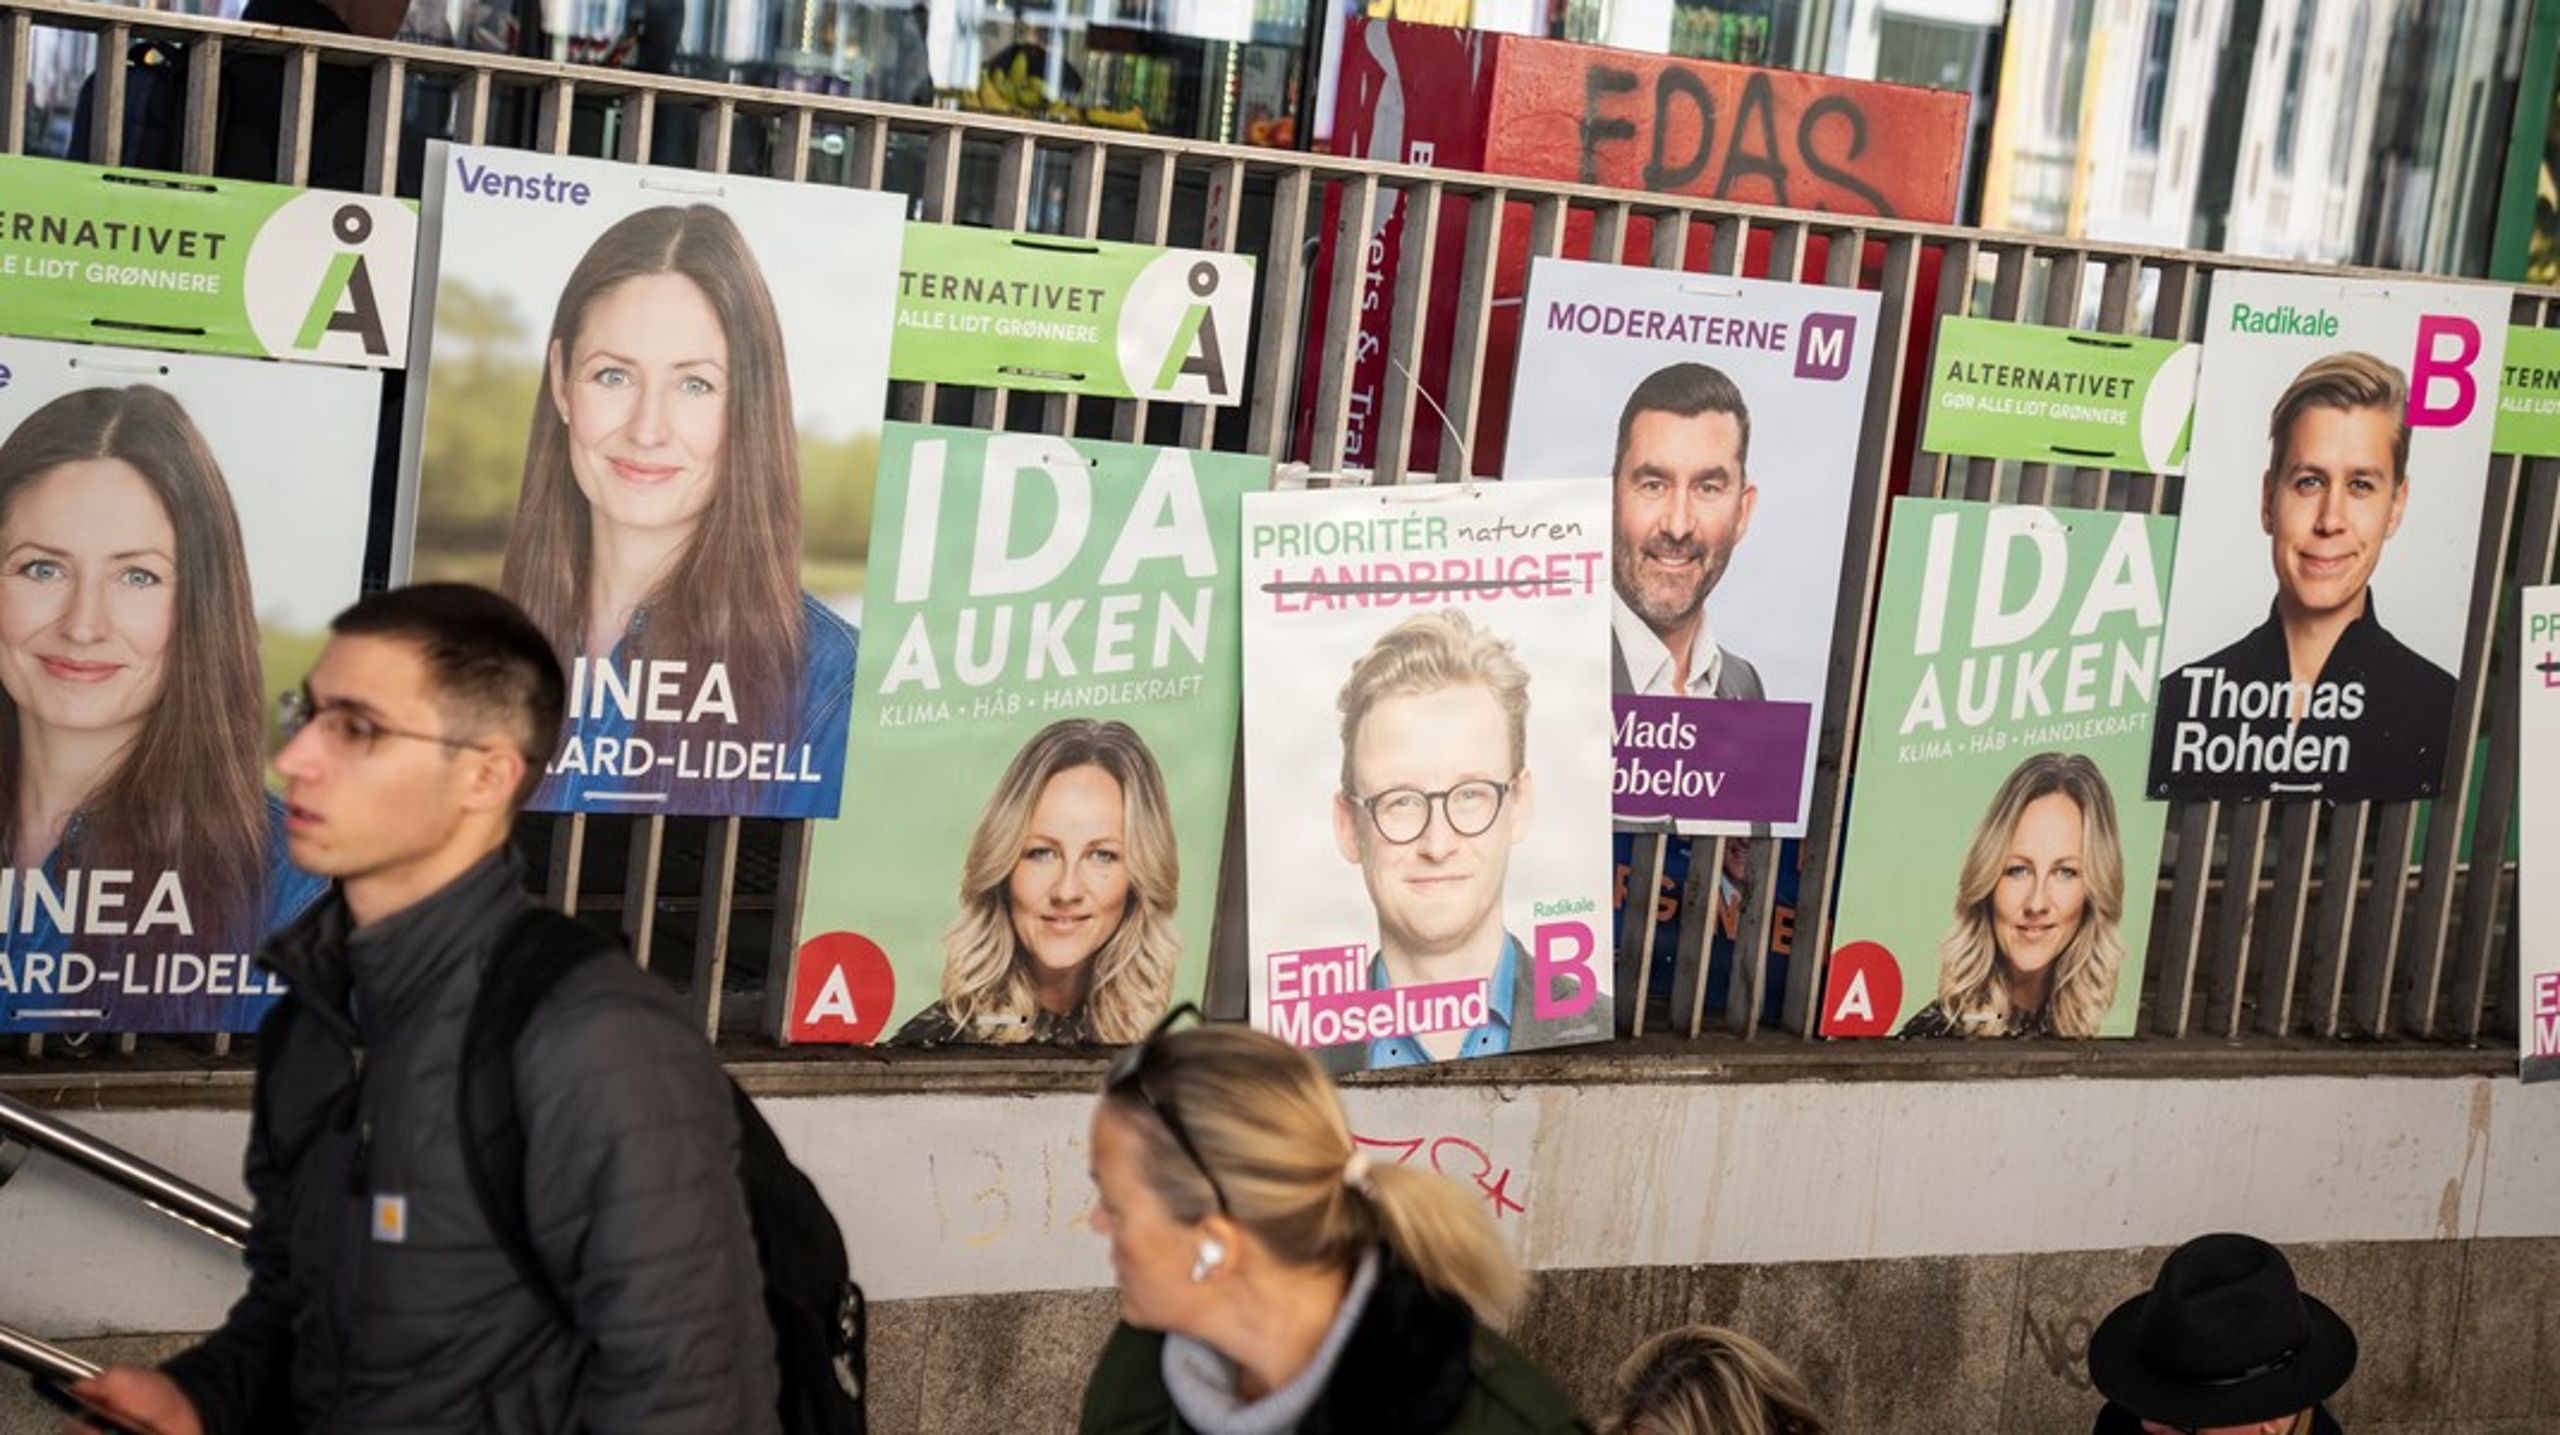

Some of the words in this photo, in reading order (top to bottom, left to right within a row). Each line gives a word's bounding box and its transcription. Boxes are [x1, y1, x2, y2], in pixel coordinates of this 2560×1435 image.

[456, 156, 591, 206] Venstre
[24, 256, 81, 281] LIDT
[85, 261, 221, 294] GRØNNERE
[293, 203, 390, 357] Å
[899, 271, 1106, 314] TERNATIVET
[897, 308, 944, 330] ALLE
[948, 313, 992, 334] LIDT
[995, 316, 1099, 343] GRØNNERE
[1153, 260, 1228, 396] Å
[1547, 301, 1788, 351] MODERATERNE
[2230, 303, 2339, 338] Radikale
[1805, 327, 1846, 368] M
[2404, 313, 2482, 429] B
[1947, 360, 2135, 399] ALTERNATIVET
[1942, 392, 1974, 410] GØR
[1978, 395, 2012, 414] ALLE
[2015, 399, 2048, 417] LIDT
[2050, 401, 2127, 426] GRØNNERE
[893, 434, 1219, 604] IDA
[1253, 511, 1448, 558] PRIORITÉR
[1458, 516, 1583, 543] naturen
[1274, 551, 1604, 613] LANDBRUGET
[1914, 505, 2164, 656] IDA
[878, 587, 1213, 695] AUKEN
[879, 702, 950, 728] KLIMA
[973, 688, 1020, 720] HÅB
[1042, 675, 1204, 711] HANDLEKRAFT
[1898, 635, 2159, 736] AUKEN
[2181, 667, 2366, 720] Thomas
[1612, 709, 1698, 750] Mads
[1898, 740, 1953, 764] KLIMA
[1969, 728, 2007, 754] HÅB
[2023, 712, 2150, 747] HANDLEKRAFT
[2171, 721, 2350, 774] Rohden
[545, 736, 822, 782] ARD-LIDELL
[1533, 898, 1595, 918] Radikale
[803, 962, 858, 1025] A
[1270, 946, 1367, 1001] Emil
[1533, 920, 1598, 1022] B
[1833, 967, 1874, 1022] A
[1271, 980, 1490, 1048] Moselund
